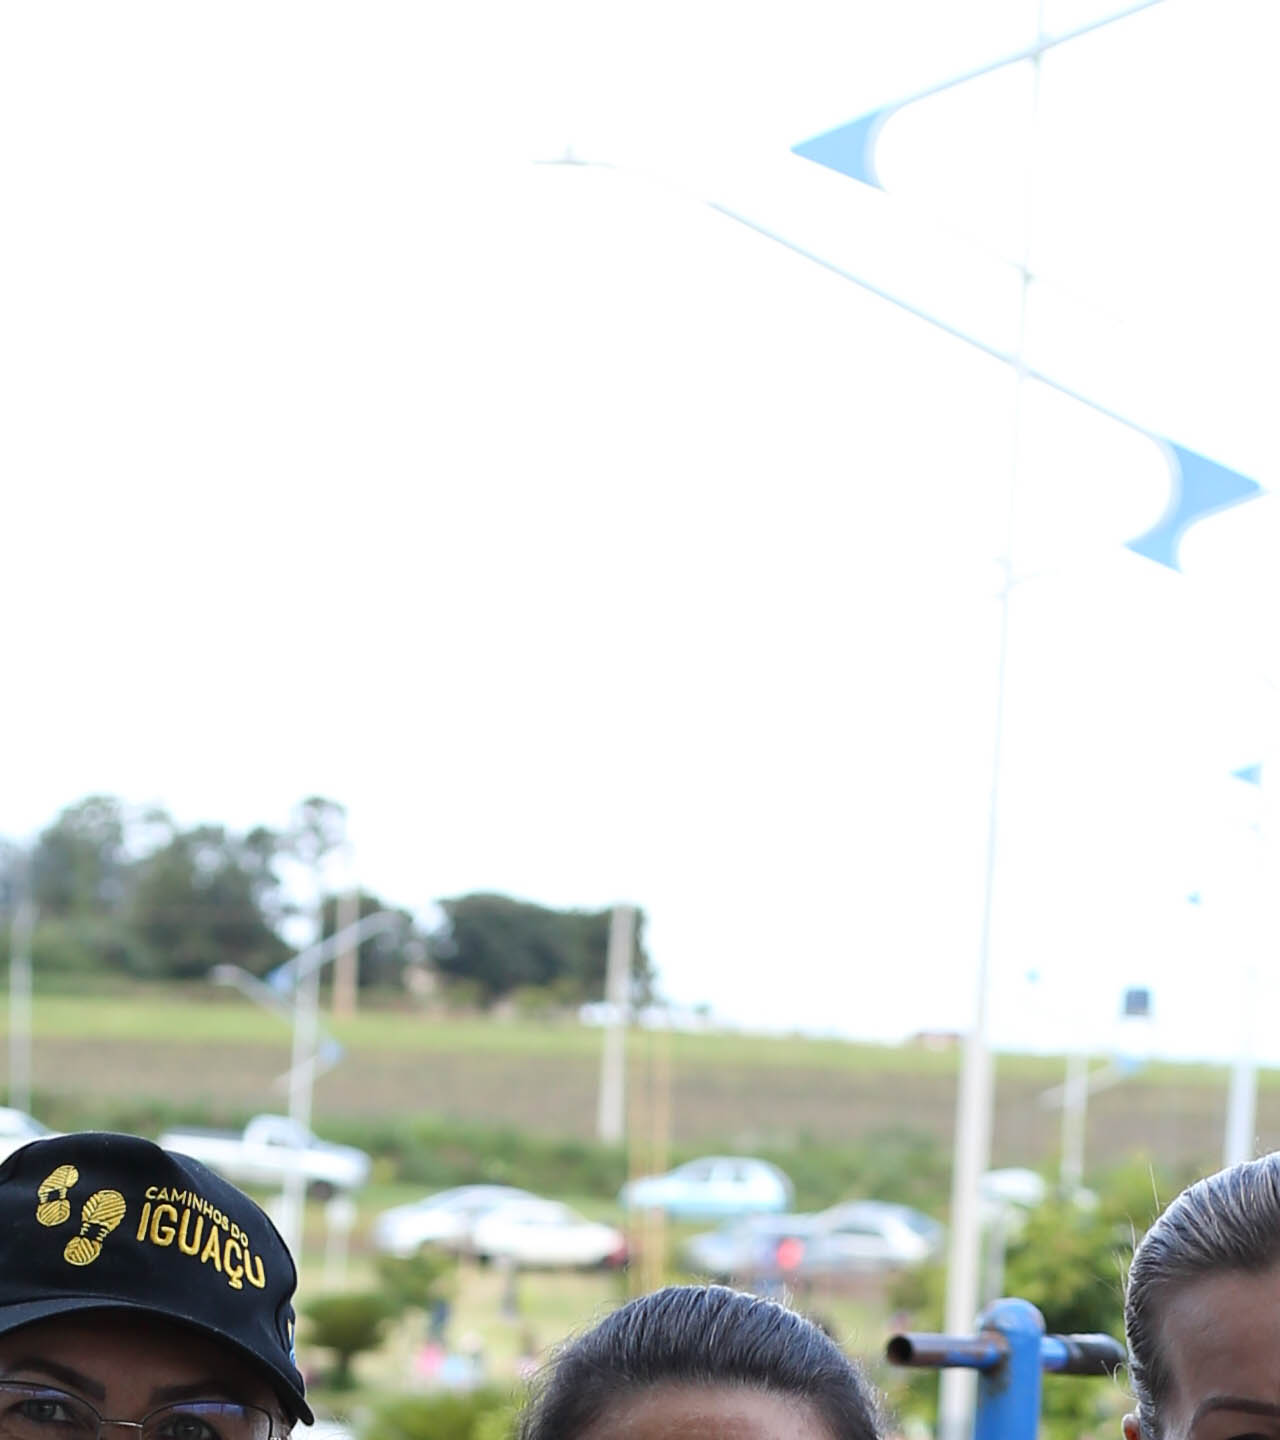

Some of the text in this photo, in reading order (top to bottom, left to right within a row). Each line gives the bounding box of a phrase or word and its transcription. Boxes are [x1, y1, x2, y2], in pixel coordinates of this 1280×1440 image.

[136, 1201, 266, 1290] IGUAÇU
[145, 1186, 249, 1248] CAMINHOS DO
